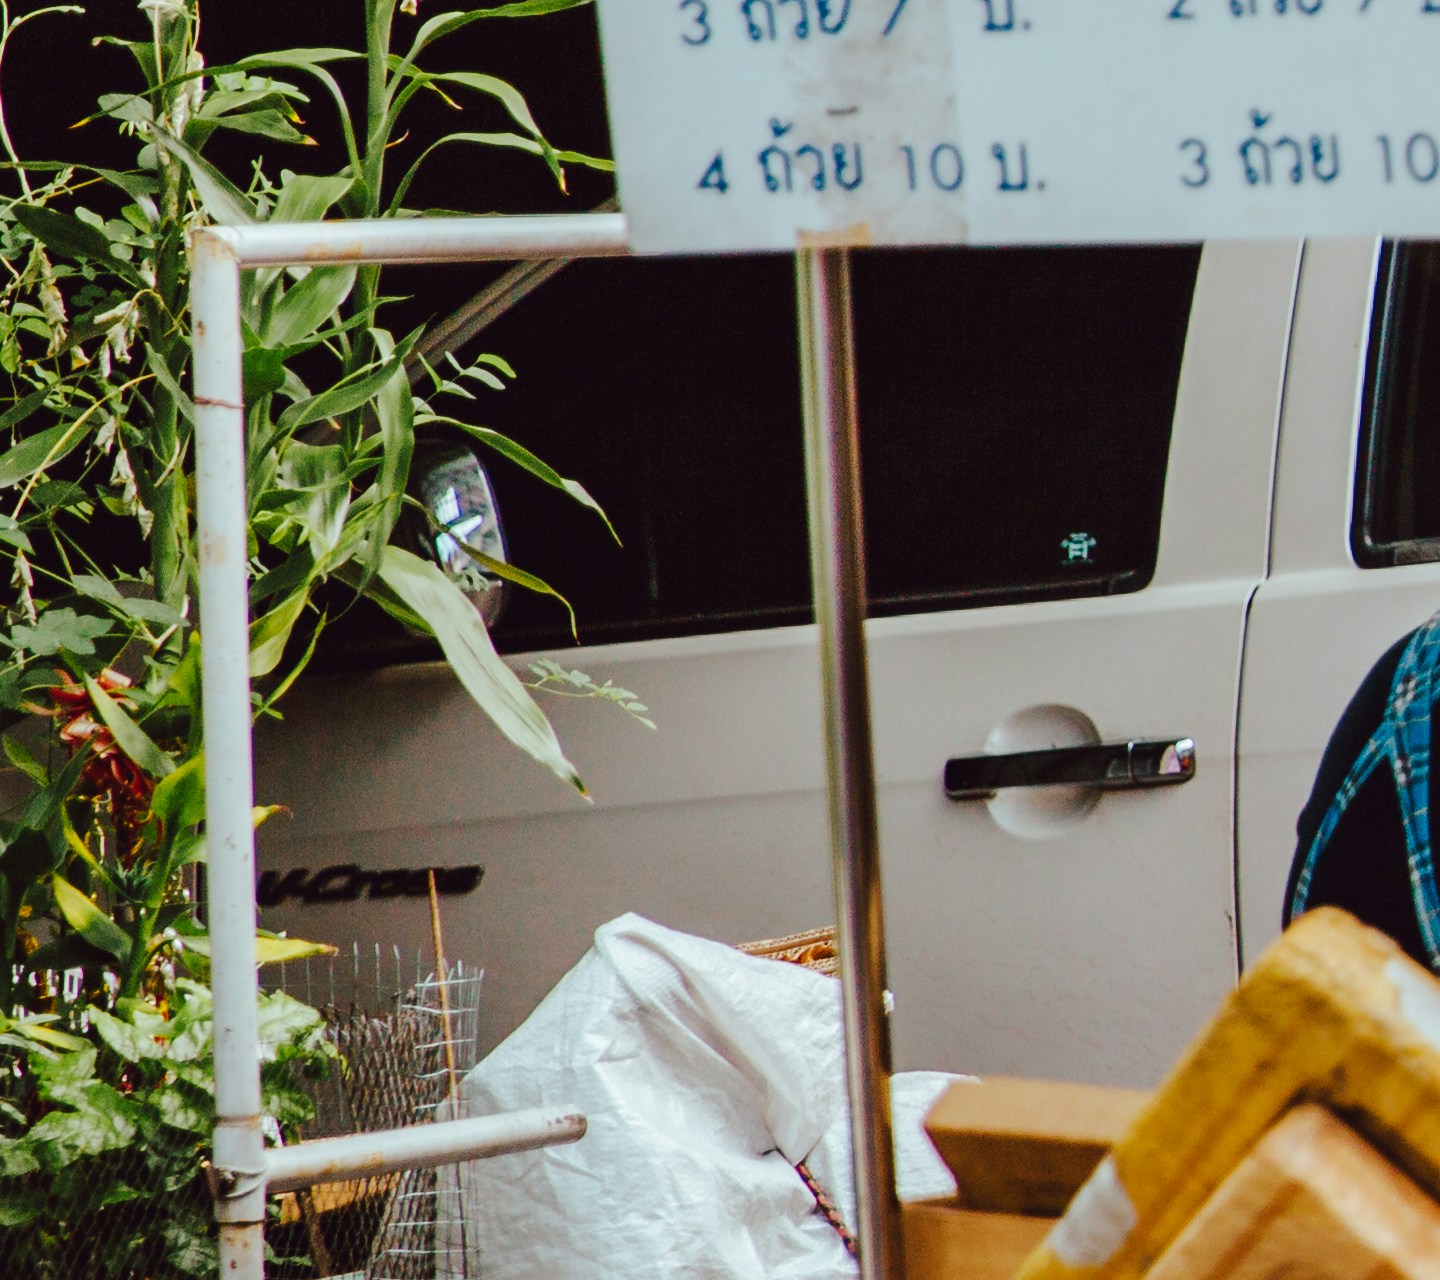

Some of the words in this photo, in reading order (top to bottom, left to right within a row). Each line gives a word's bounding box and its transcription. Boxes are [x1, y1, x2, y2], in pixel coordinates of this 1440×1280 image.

[698, 155, 729, 194] 4
[758, 120, 863, 193] ถ้วย
[900, 143, 965, 193] 10
[993, 143, 1046, 192] บ.
[1180, 138, 1210, 189] 3
[1239, 111, 1339, 185] ถ้วย
[1377, 132, 1440, 184] 10
